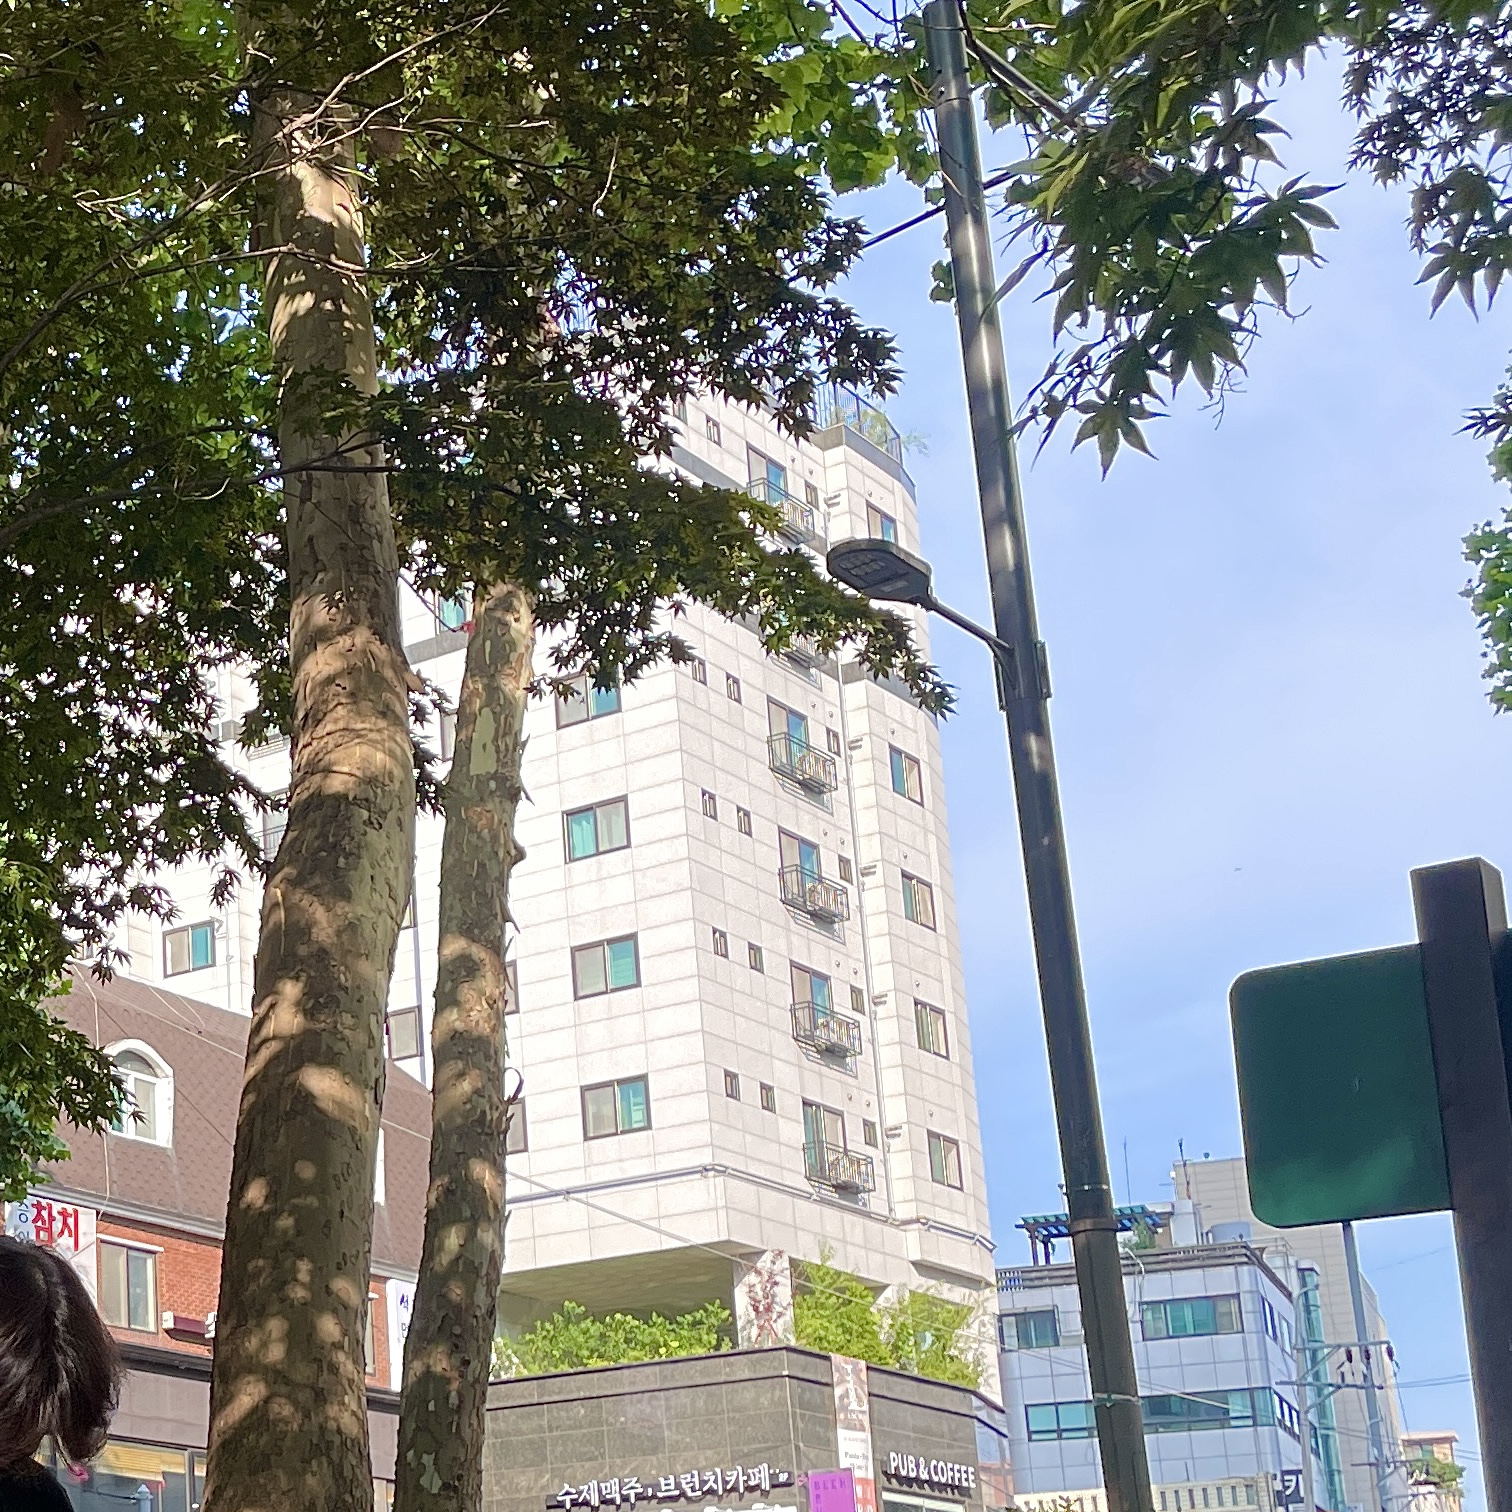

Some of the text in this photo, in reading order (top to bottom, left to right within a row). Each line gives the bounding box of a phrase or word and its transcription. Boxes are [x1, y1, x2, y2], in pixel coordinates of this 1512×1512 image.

[31, 1199, 79, 1252] 참치
[656, 1462, 771, 1500] 브런치카페
[889, 1451, 918, 1479] PUB
[918, 1457, 930, 1481] &
[930, 1459, 977, 1489] COFFEE
